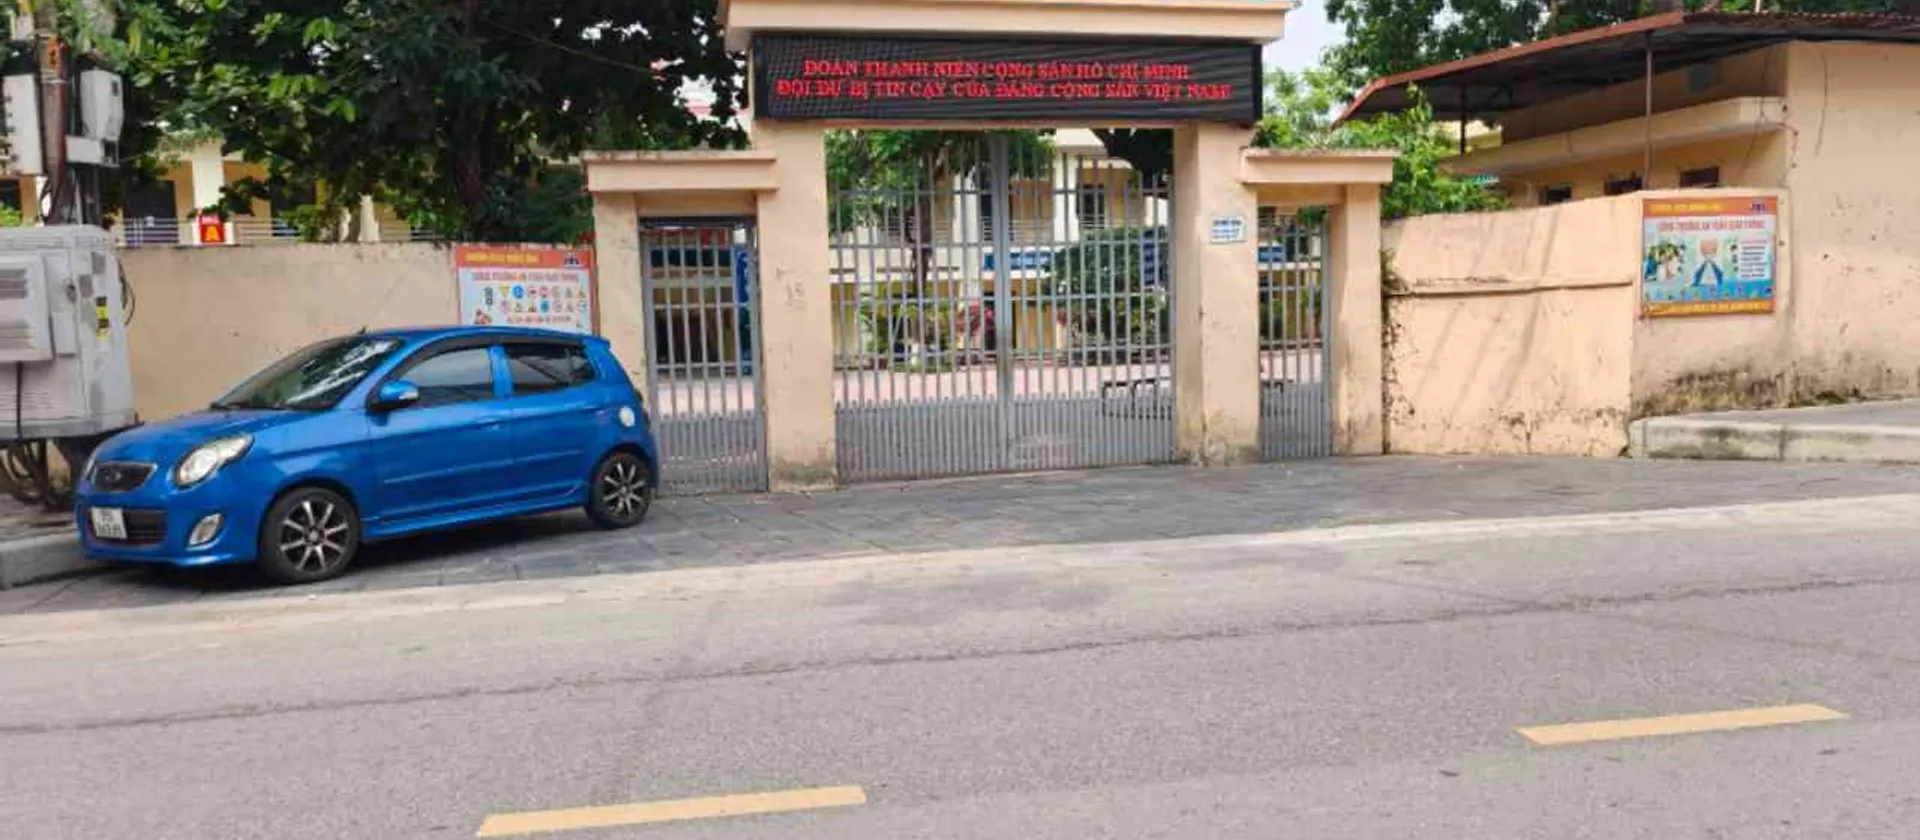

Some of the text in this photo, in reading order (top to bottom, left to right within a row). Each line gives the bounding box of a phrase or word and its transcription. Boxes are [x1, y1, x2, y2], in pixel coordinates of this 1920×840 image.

[863, 61, 928, 77] THANH
[934, 60, 978, 78] NIÊN
[1144, 64, 1189, 80] MINH
[851, 79, 867, 99] BỊ
[874, 81, 905, 97] TIN
[1144, 82, 1181, 102] VIỆT
[205, 226, 220, 241] A
